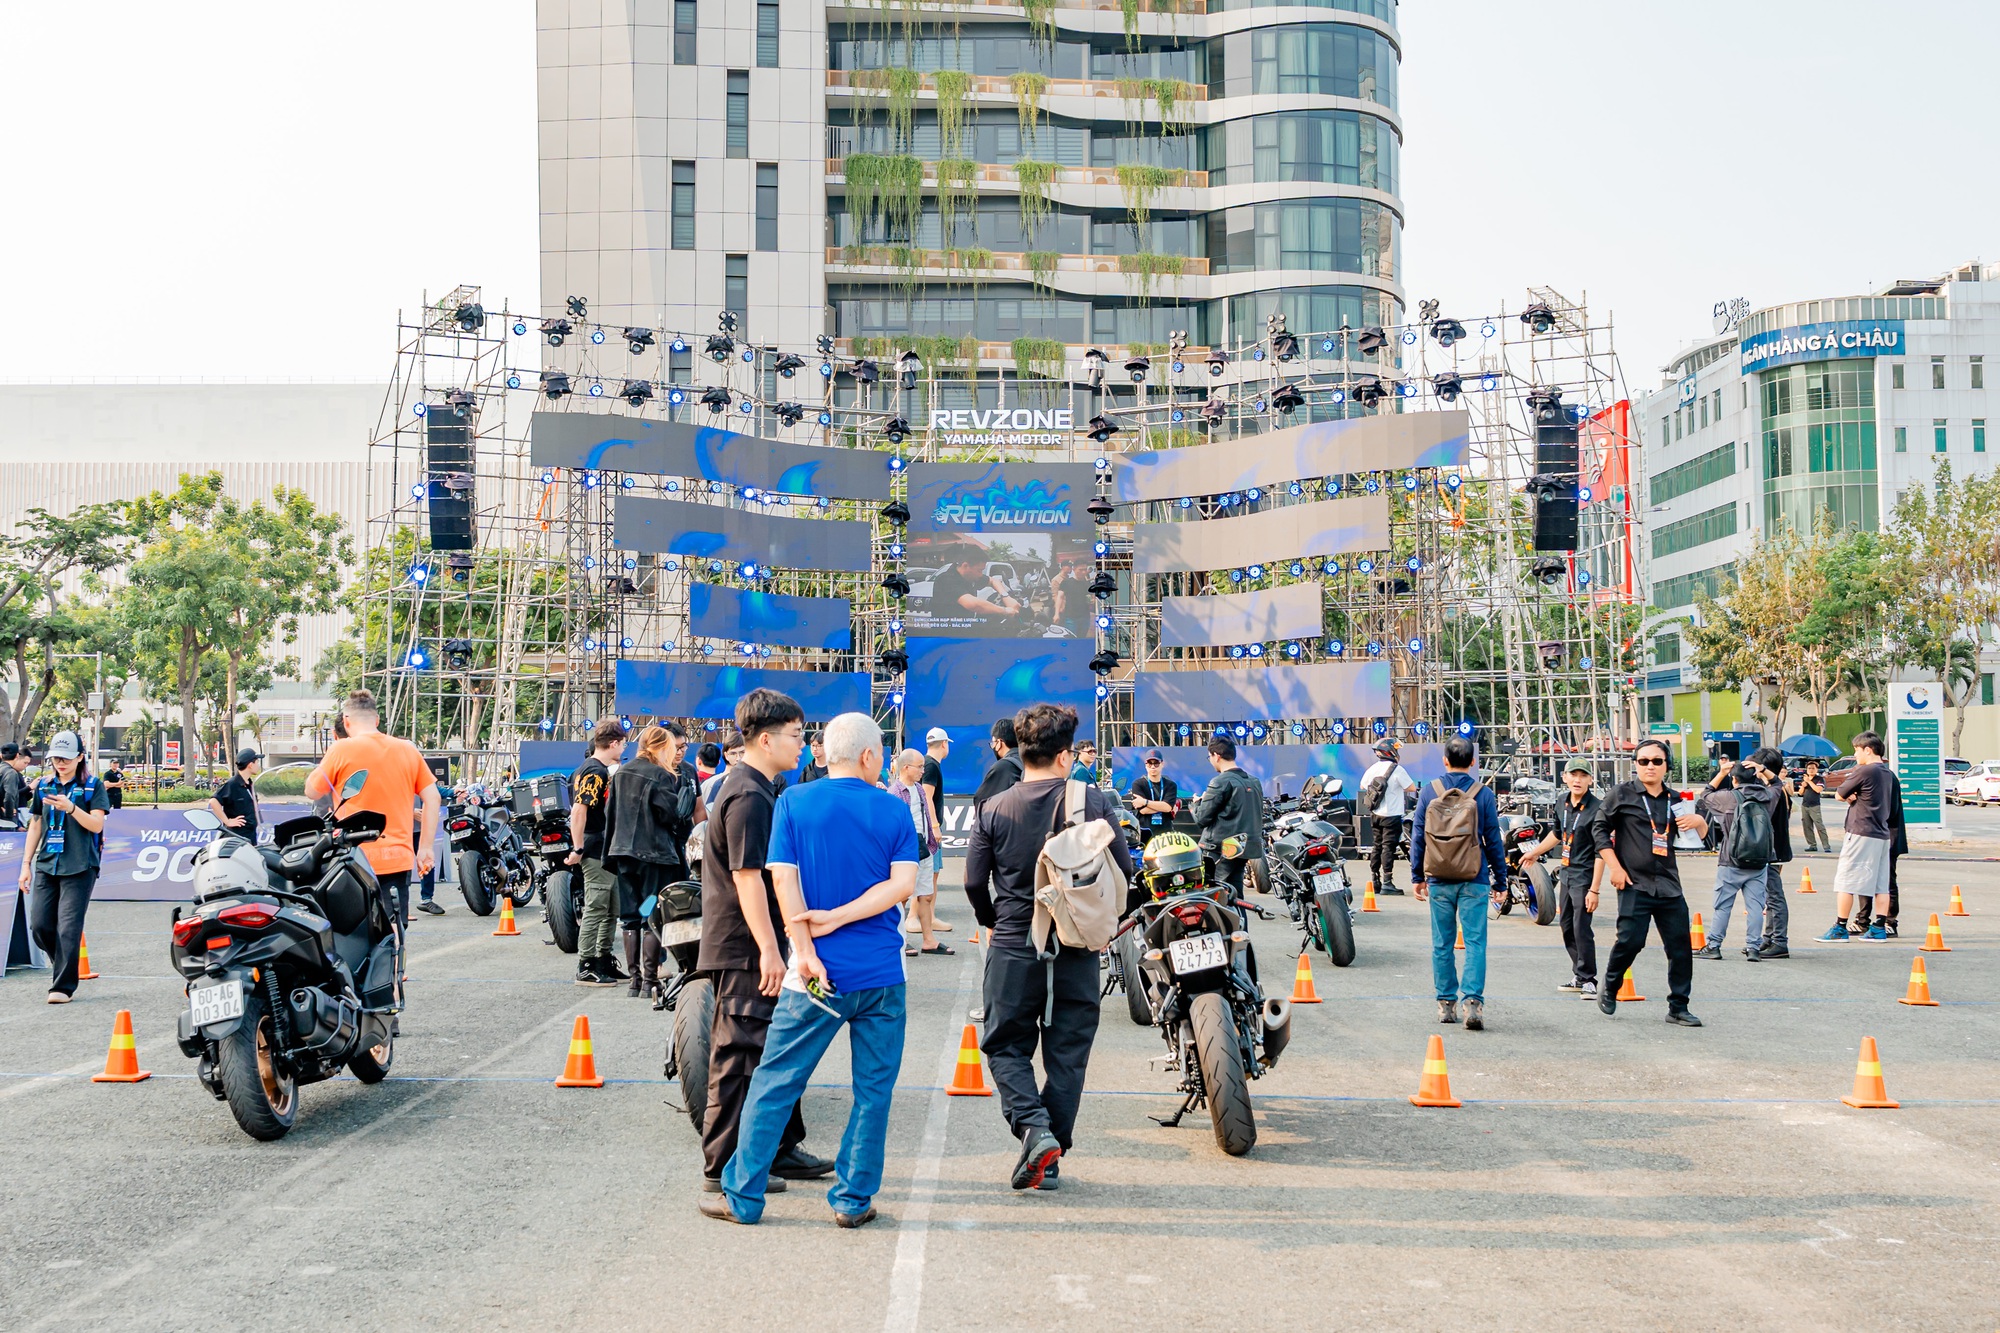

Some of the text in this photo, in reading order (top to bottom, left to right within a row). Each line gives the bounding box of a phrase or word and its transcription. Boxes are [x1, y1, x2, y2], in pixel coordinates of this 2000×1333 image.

[1769, 335, 1822, 357] HÀNG
[1824, 329, 1838, 350] Á
[1841, 327, 1898, 348] CHÂU
[1679, 377, 1696, 404] ACB
[930, 408, 1074, 430] REVZONE
[943, 434, 1062, 445] YAMAHA MOTOR
[140, 830, 212, 843] YAMAHA
[1152, 833, 1190, 853] GRAZIE
[1178, 936, 1215, 956] 59-A3
[1177, 950, 1223, 971] 247.73
[198, 983, 234, 1006] 60-AG
[194, 999, 240, 1023] 003.04
